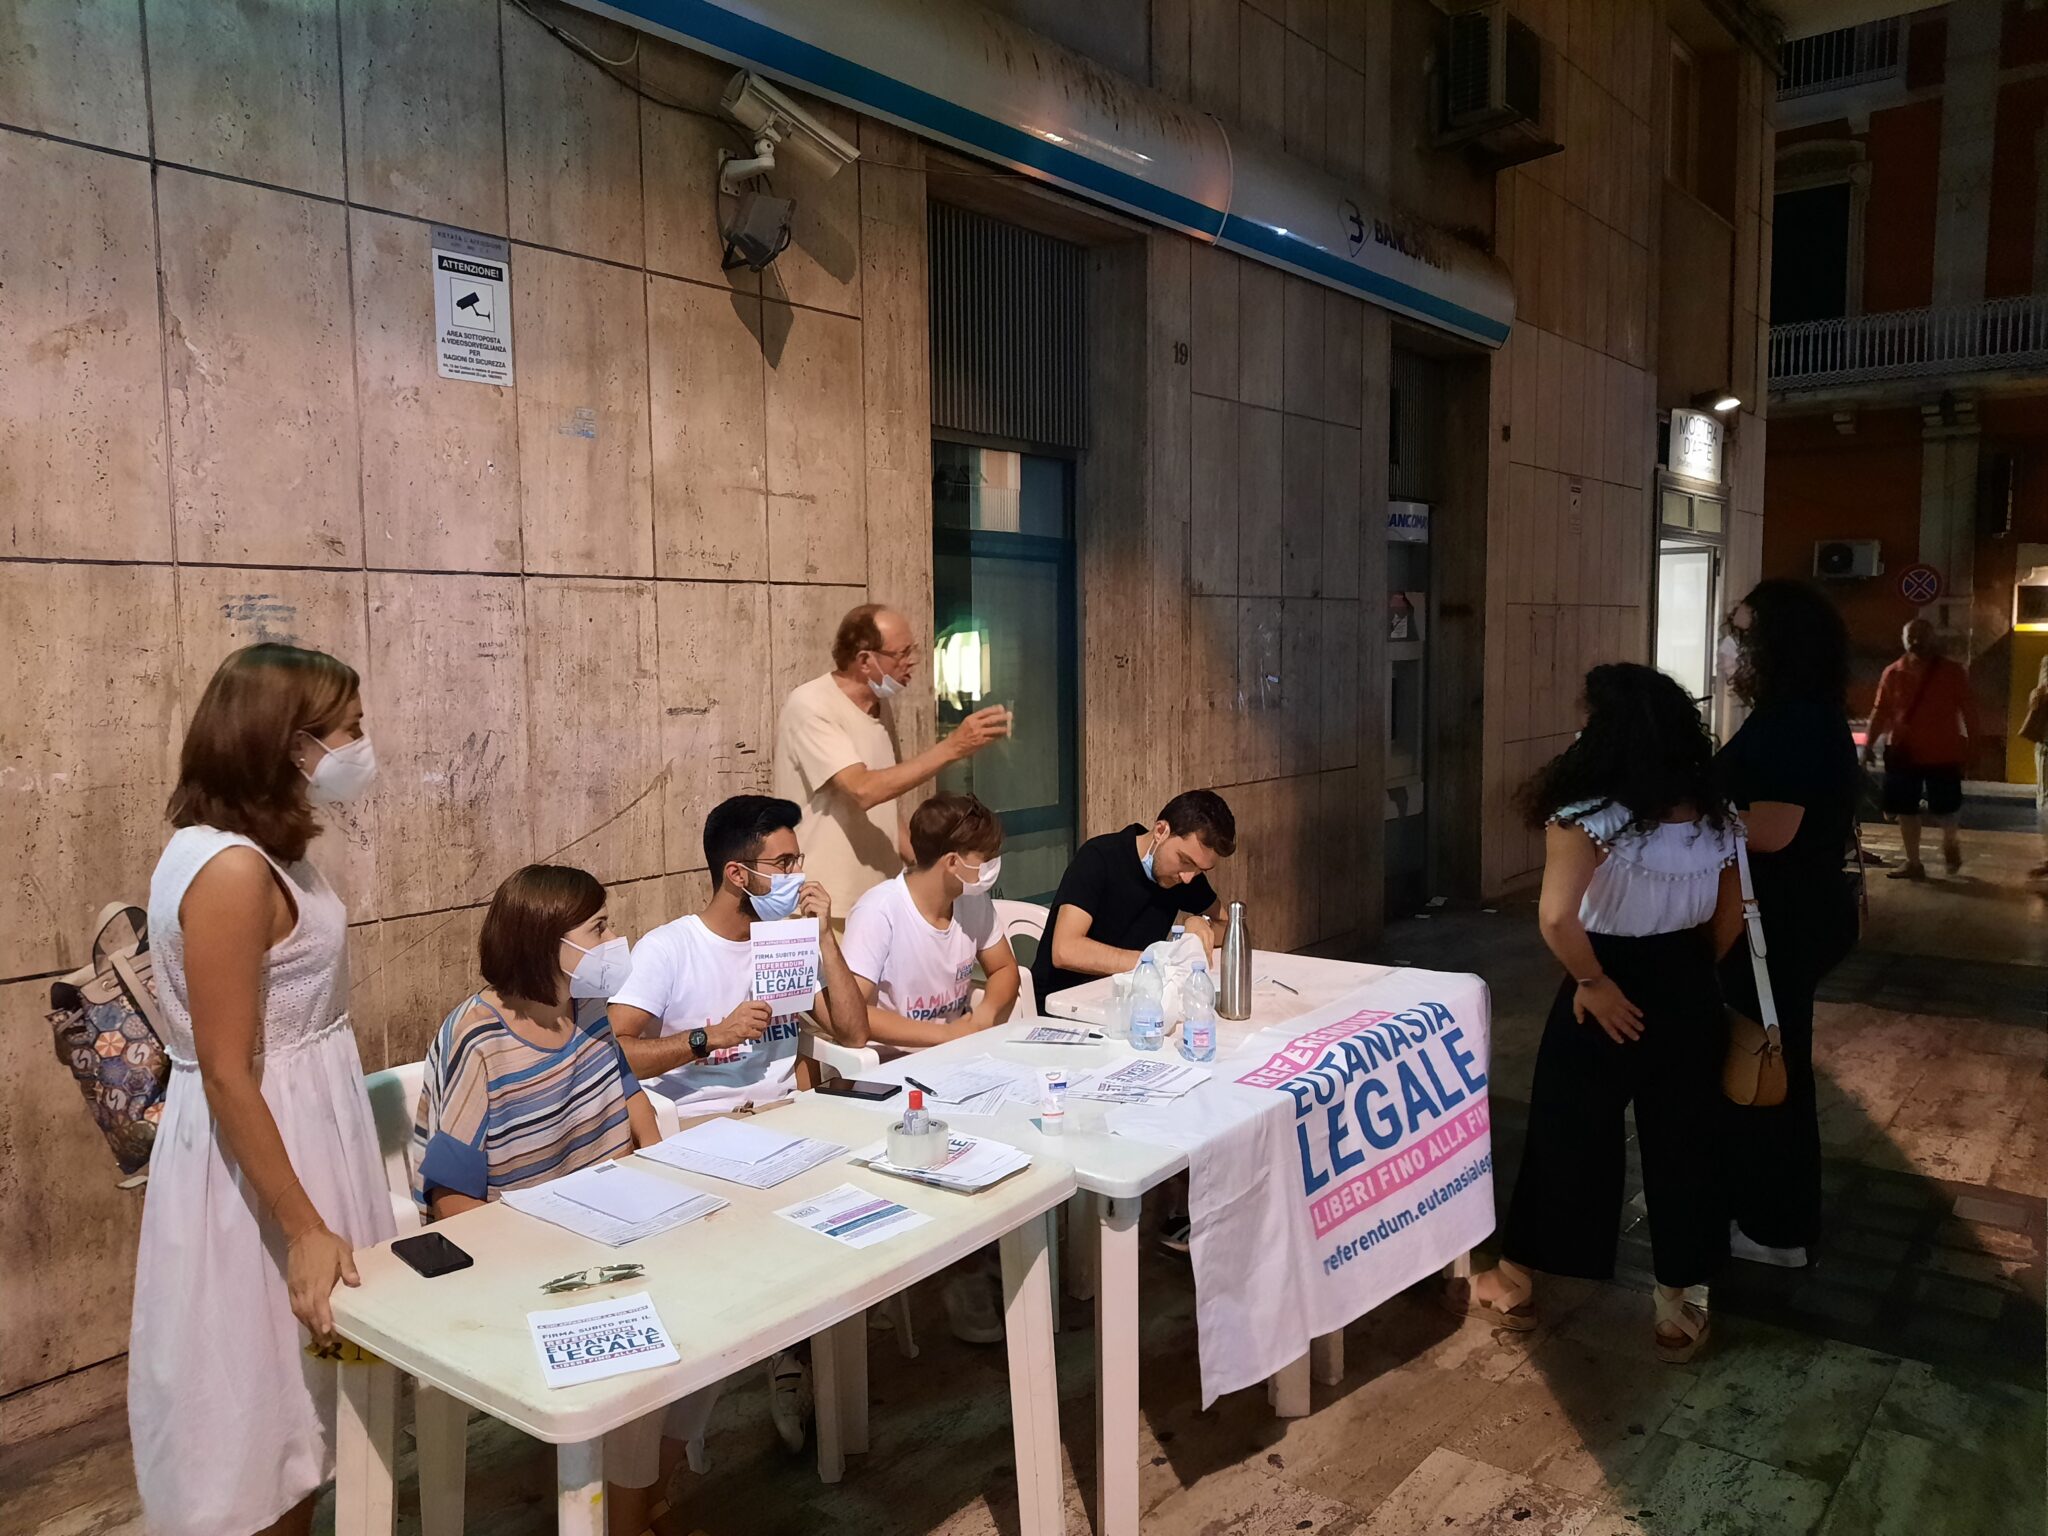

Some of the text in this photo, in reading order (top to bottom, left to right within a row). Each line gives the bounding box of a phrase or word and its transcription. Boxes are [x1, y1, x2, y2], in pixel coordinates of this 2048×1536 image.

[447, 330, 501, 344] AREA SOTTOPOSTA
[447, 338, 507, 353] VIDEOSORVEGLIANZA
[443, 353, 468, 363] RAGIONI
[475, 358, 506, 368] SICUREZZA
[1173, 341, 1188, 365] 19
[755, 966, 814, 980] EUTANASIA
[756, 960, 804, 970] REFERENDUM
[756, 975, 814, 994] LEGALE
[907, 996, 924, 1011] LA
[1241, 1012, 1386, 1086] REFERENDUM
[1275, 1002, 1455, 1119] EUTANASIA
[1297, 1027, 1487, 1196] LEGALE
[1313, 1103, 1490, 1230] LIBERI FINO ALLA FIN
[1323, 1152, 1492, 1276] referendum.eutanasialeg
[542, 1330, 576, 1339] FIRMA
[579, 1322, 614, 1332] SUBITO
[619, 1317, 638, 1325] PER
[546, 1326, 633, 1346] REFERENDUM
[546, 1327, 660, 1354] EUTANASIA
[548, 1334, 663, 1364] LEGALE
[553, 1361, 587, 1369] LIBERI
[590, 1354, 612, 1363] FINO
[614, 1349, 639, 1357] ALLA
